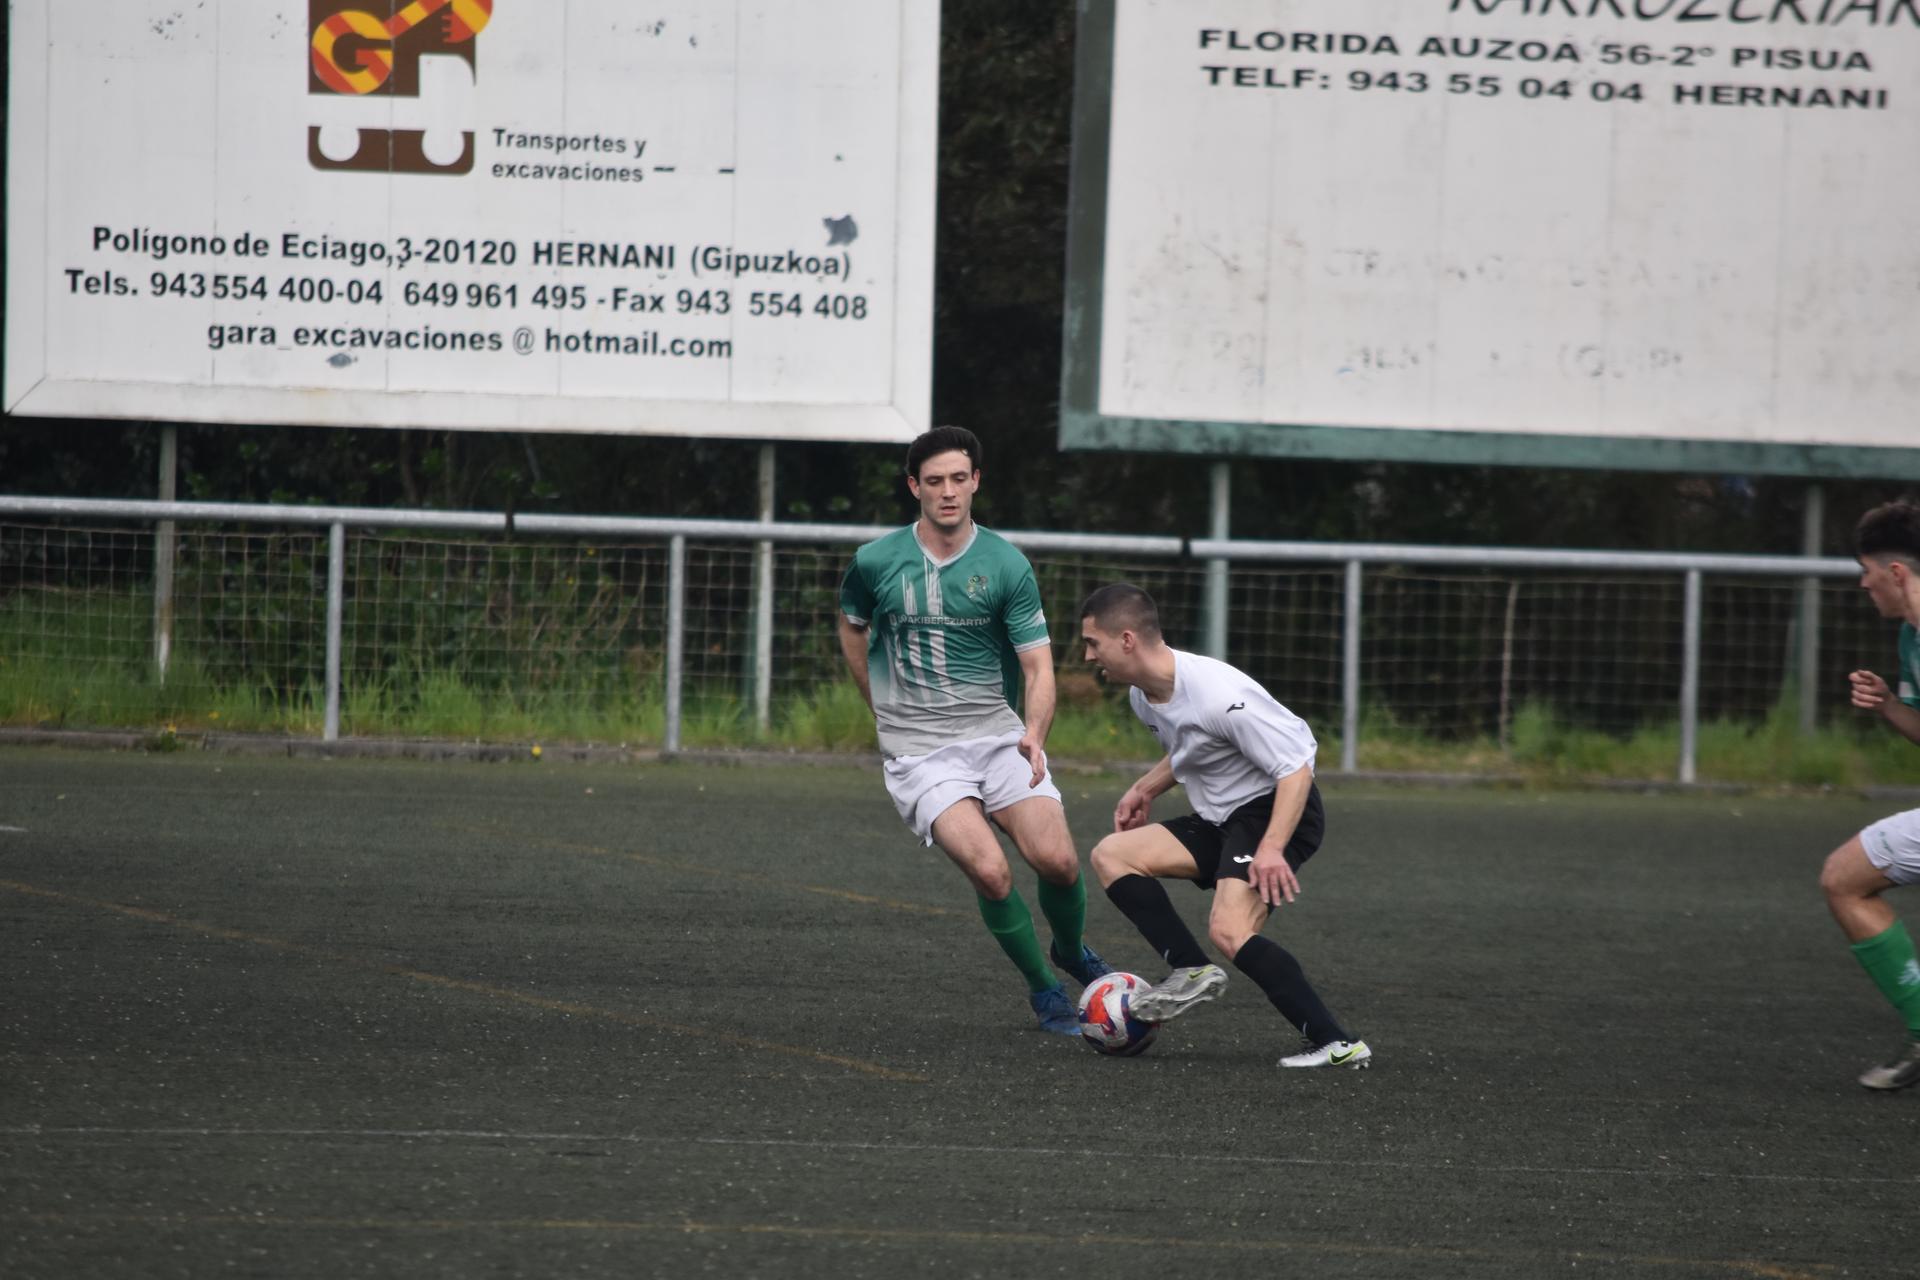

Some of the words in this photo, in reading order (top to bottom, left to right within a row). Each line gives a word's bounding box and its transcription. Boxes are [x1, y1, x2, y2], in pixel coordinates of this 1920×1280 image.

[1199, 29, 1400, 56] FLORIDA
[1418, 36, 1581, 64] AUZOA
[1731, 47, 1873, 72] PISUA
[1201, 65, 1330, 90] TELF:
[1348, 70, 1430, 93] 943
[1448, 73, 1502, 98] 55
[1518, 78, 1573, 100] 04
[1589, 81, 1644, 103] 04
[1673, 84, 1889, 110] HERNANI
[492, 128, 627, 153] Transportes
[635, 140, 647, 158] y
[491, 162, 644, 182] excavaciones
[92, 225, 228, 261] Polígono
[232, 232, 271, 258] de
[532, 241, 675, 270] HERNANI
[690, 245, 852, 281] (Gipuzkoa)
[64, 268, 139, 297] Tels.
[149, 271, 207, 299] 943
[211, 274, 269, 301] 554
[277, 277, 384, 305] 400-04
[403, 281, 459, 308] 649
[465, 283, 518, 309] 961
[530, 284, 587, 311] 495
[612, 287, 665, 313] Fax
[676, 289, 732, 315] 943
[749, 292, 803, 317] 554
[813, 294, 868, 320] 408
